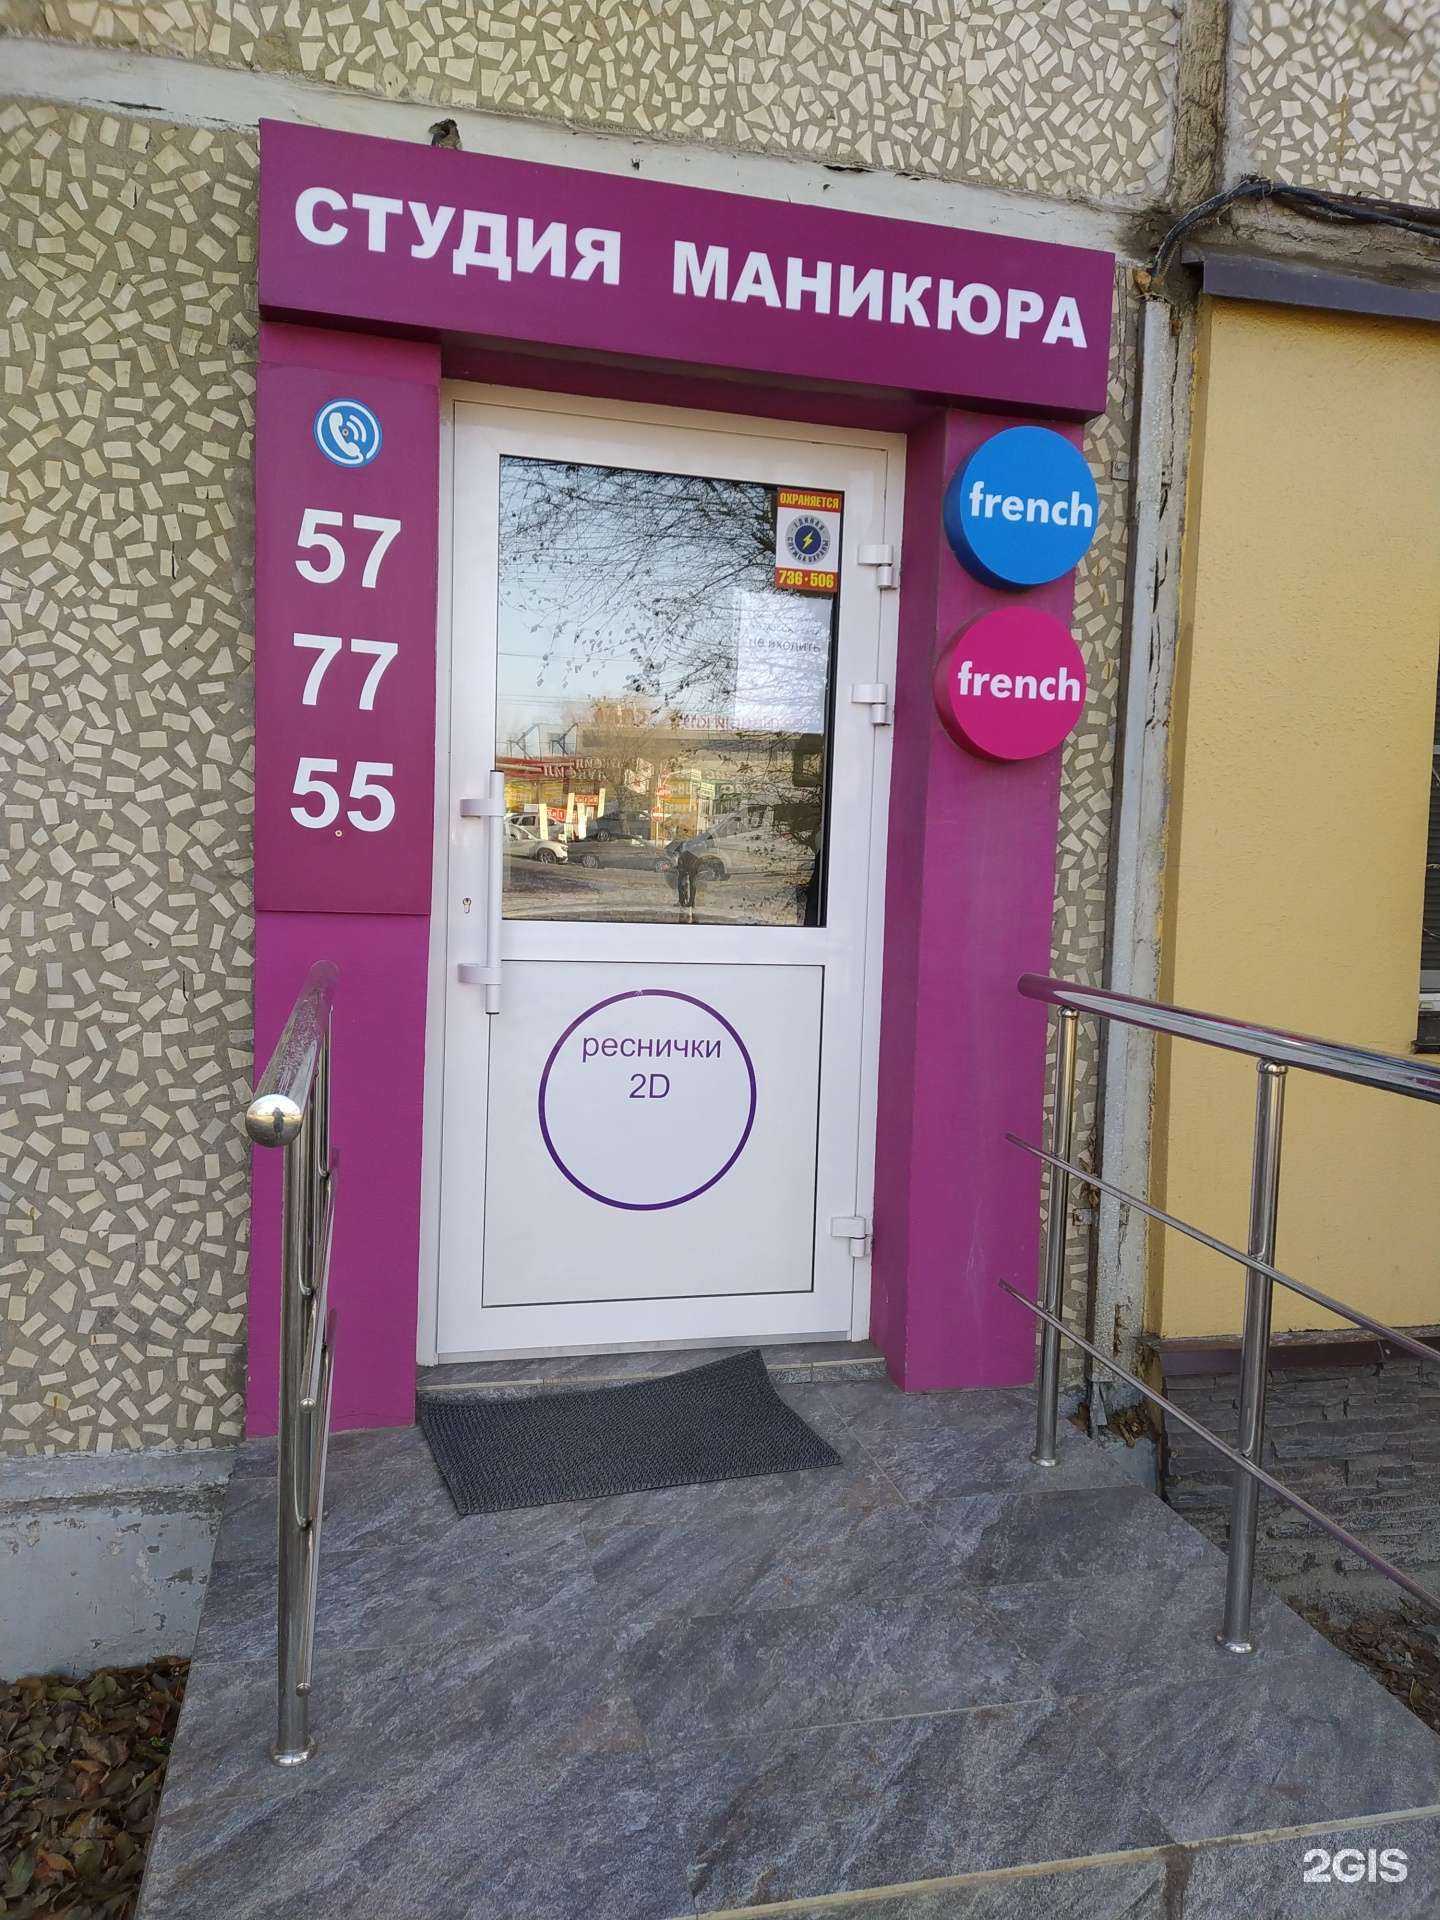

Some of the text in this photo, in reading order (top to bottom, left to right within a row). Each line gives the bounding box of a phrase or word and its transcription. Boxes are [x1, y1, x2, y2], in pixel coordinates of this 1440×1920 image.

[295, 187, 1088, 349] СТУДИЯ МАНИКЮРА
[779, 492, 840, 509] ОХРАНЯЕТСЯ
[969, 481, 1093, 528] french
[295, 508, 402, 589] 57
[293, 632, 399, 711] 77
[957, 660, 1081, 702] french
[290, 757, 396, 832] 55
[582, 1036, 722, 1063] реснички
[629, 1073, 671, 1099] 2D
